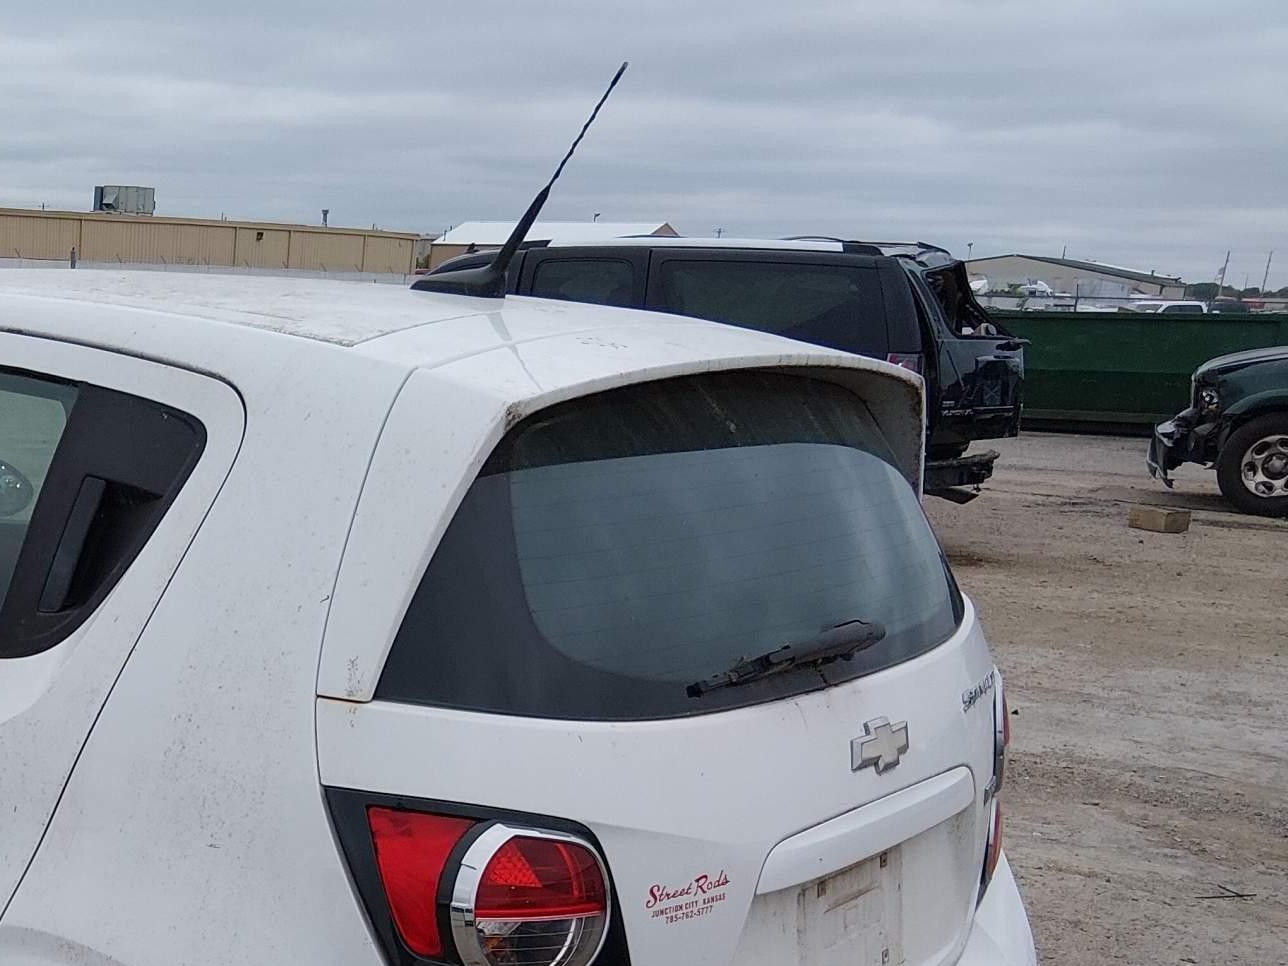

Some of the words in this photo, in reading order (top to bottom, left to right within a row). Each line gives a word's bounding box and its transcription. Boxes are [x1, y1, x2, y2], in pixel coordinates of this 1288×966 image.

[645, 882, 693, 909] Street
[693, 869, 731, 897] Rods
[651, 903, 684, 918] JUNCTION
[702, 893, 726, 905] KANSAS
